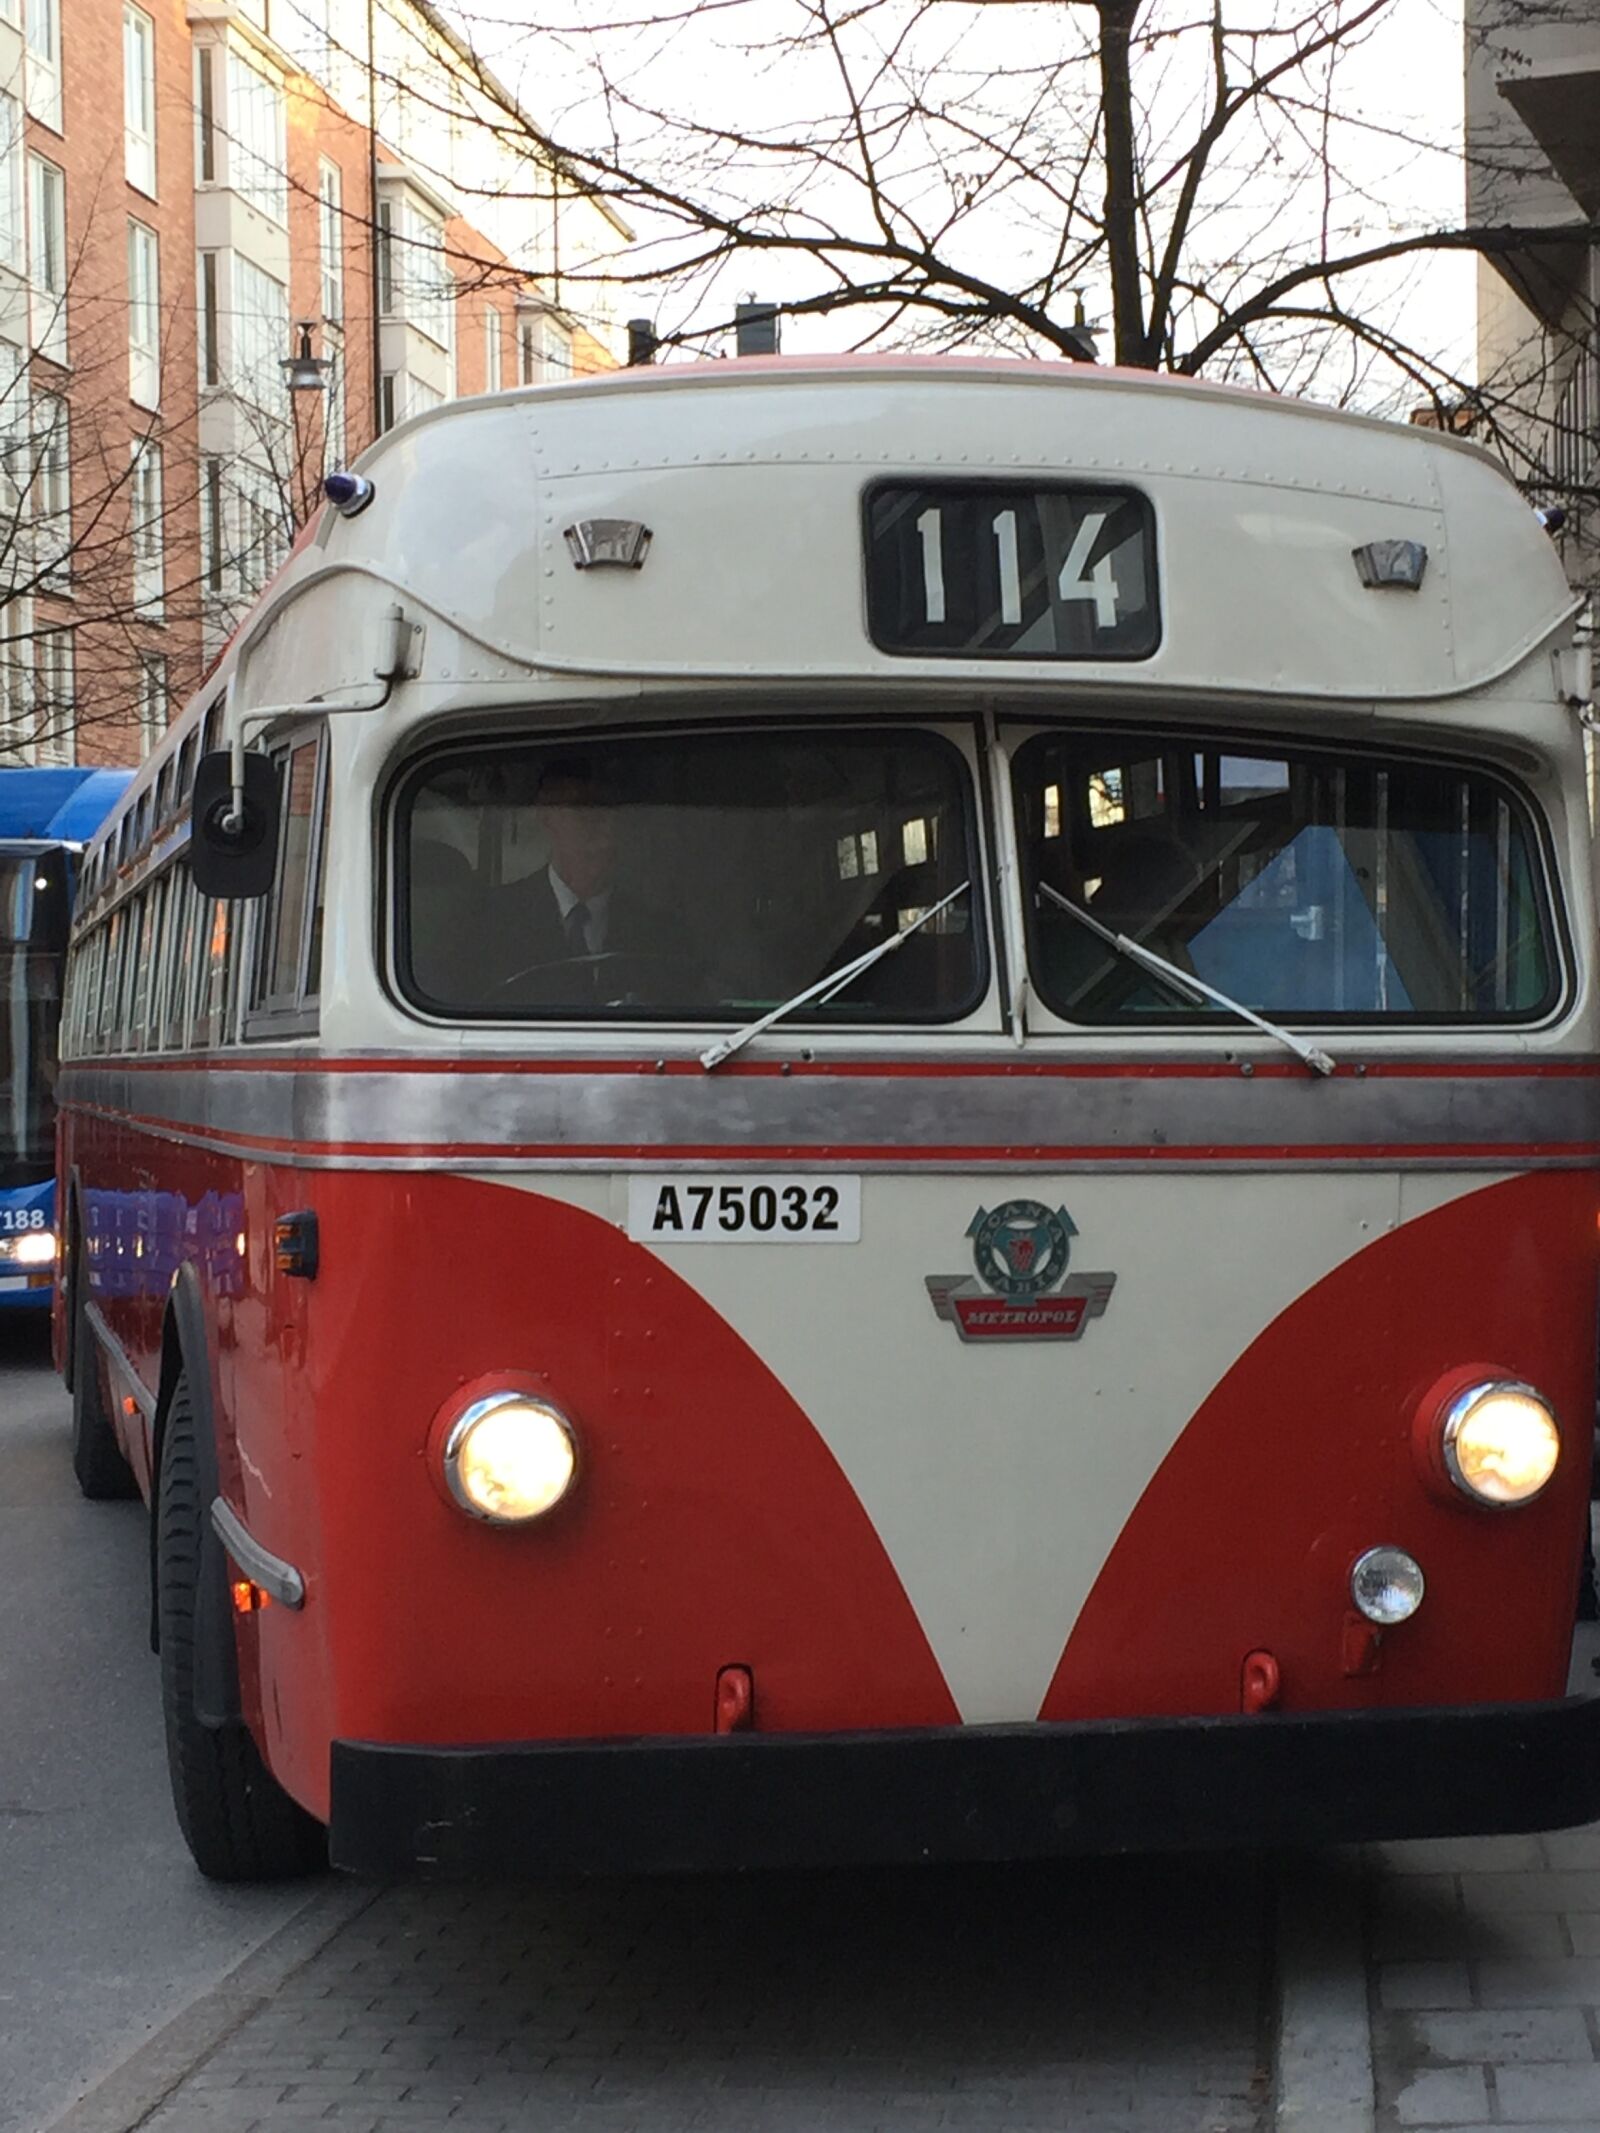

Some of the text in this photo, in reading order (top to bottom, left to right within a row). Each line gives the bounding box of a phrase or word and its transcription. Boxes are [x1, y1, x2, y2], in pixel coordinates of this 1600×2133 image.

[917, 508, 1119, 628] 114
[0, 1209, 45, 1230] 188
[652, 1185, 839, 1231] A75032
[966, 1310, 1077, 1325] METROPOL
